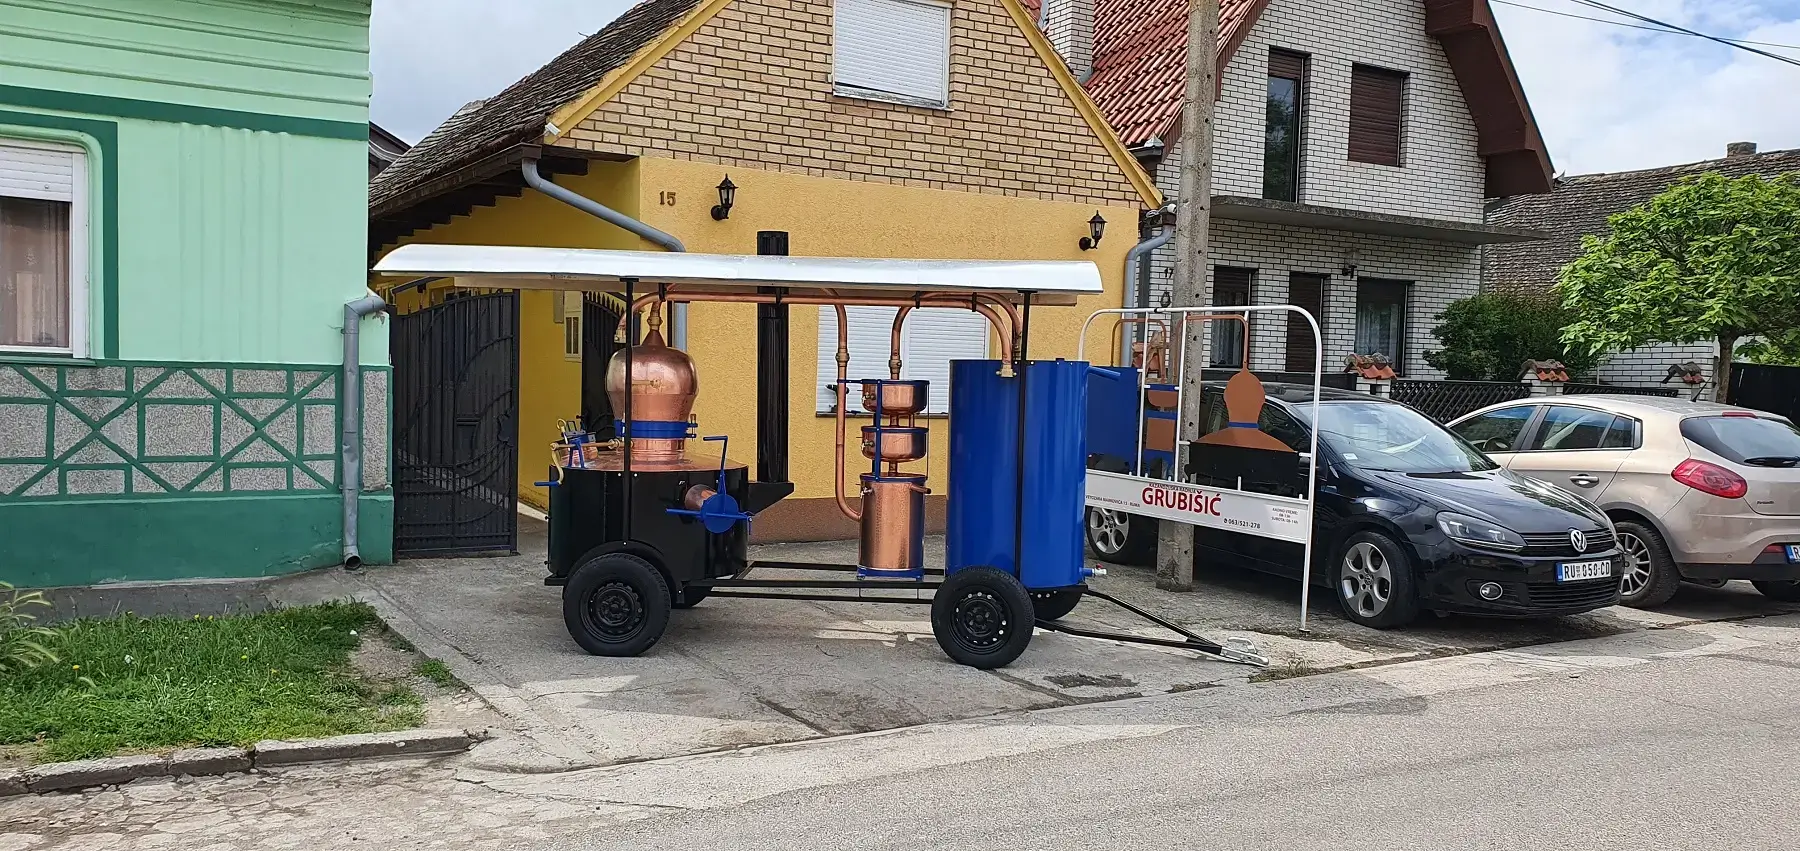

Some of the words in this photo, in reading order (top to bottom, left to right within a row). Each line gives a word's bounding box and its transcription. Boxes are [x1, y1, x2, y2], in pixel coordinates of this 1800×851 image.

[660, 191, 676, 206] 15
[1142, 487, 1222, 516] GRUBIŠIĆ
[1228, 518, 1261, 529] 063/521-278
[1564, 565, 1576, 579] RU
[1582, 562, 1610, 577] 050-CD
